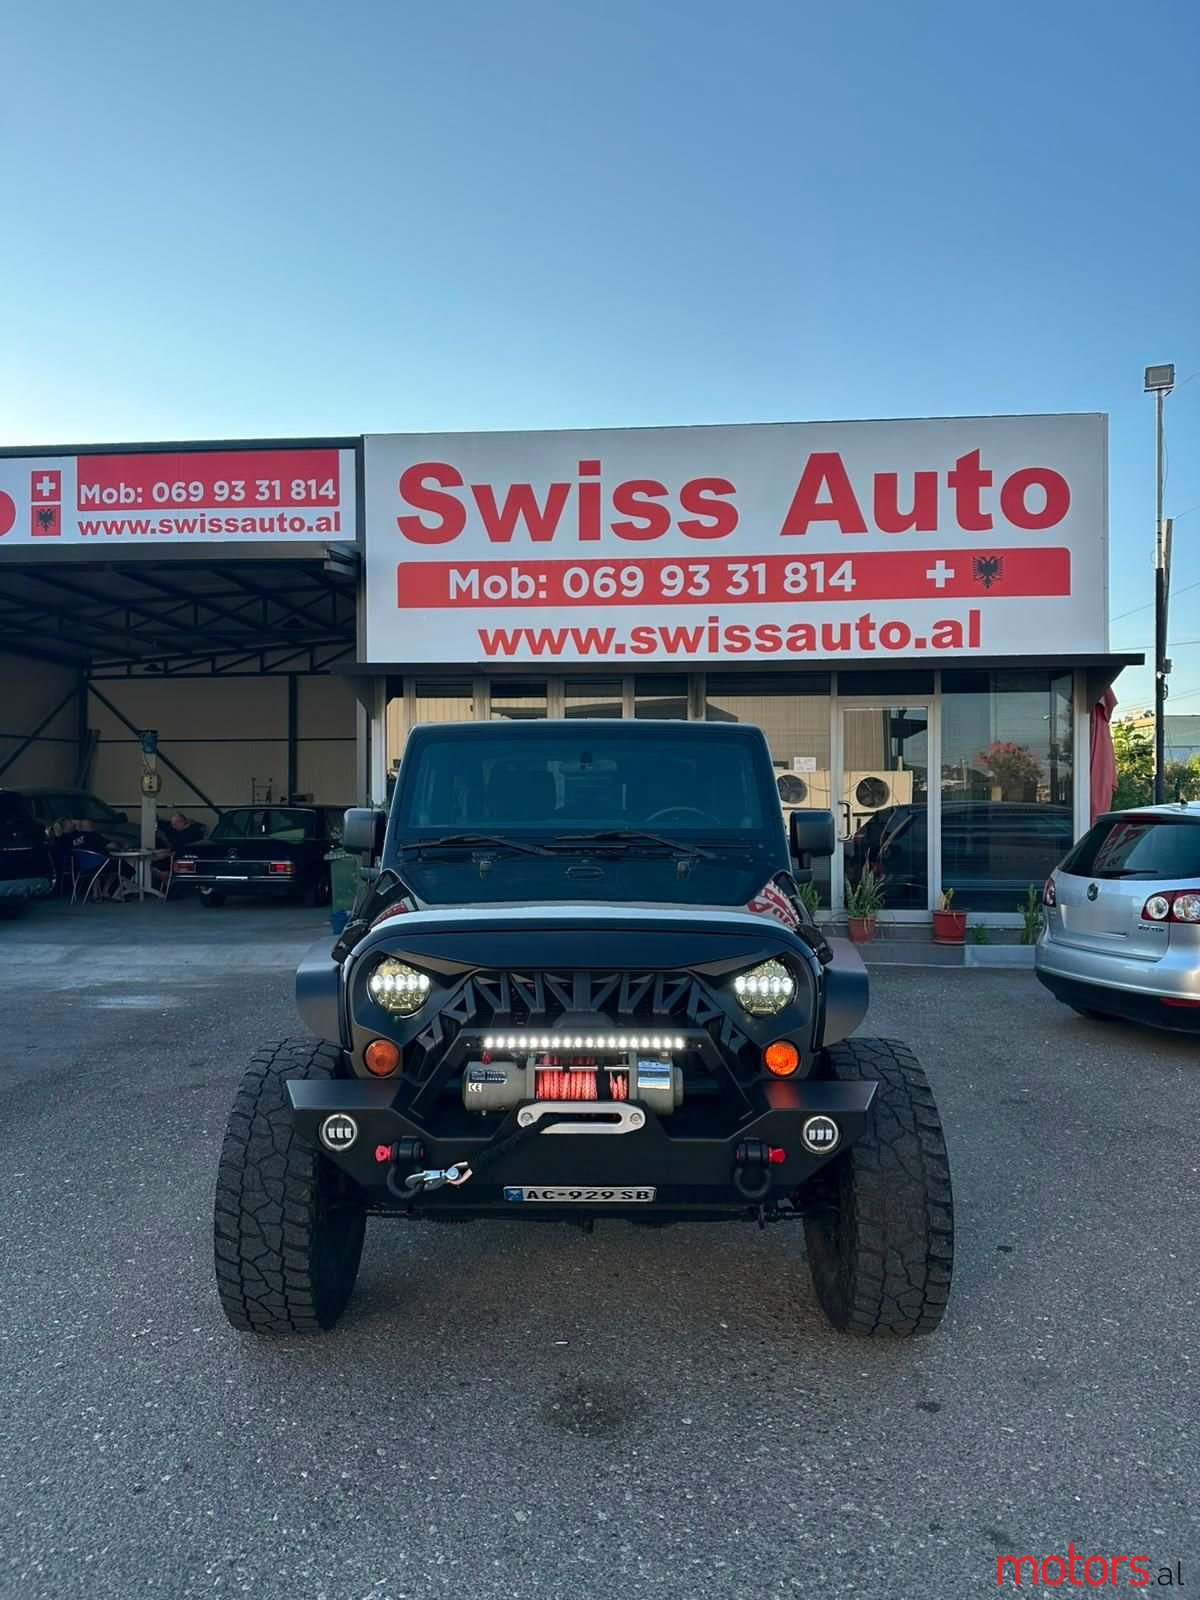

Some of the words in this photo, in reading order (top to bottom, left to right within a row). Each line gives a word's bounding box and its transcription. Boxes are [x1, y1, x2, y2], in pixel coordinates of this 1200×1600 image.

[80, 483, 143, 505] Mob:
[152, 481, 204, 503] 069
[213, 480, 246, 502] 93
[255, 479, 281, 501] 31
[290, 478, 336, 501] 814
[397, 459, 738, 545] Swiss
[780, 449, 1071, 536] Auto
[77, 511, 341, 536] www.swissauto.al
[448, 566, 547, 600] Mob:
[562, 566, 645, 599] 069
[659, 564, 710, 597] 93
[725, 562, 766, 596] 31
[783, 560, 857, 594] 814
[478, 609, 981, 657] www.swissauto.al
[621, 1190, 650, 1200] SB
